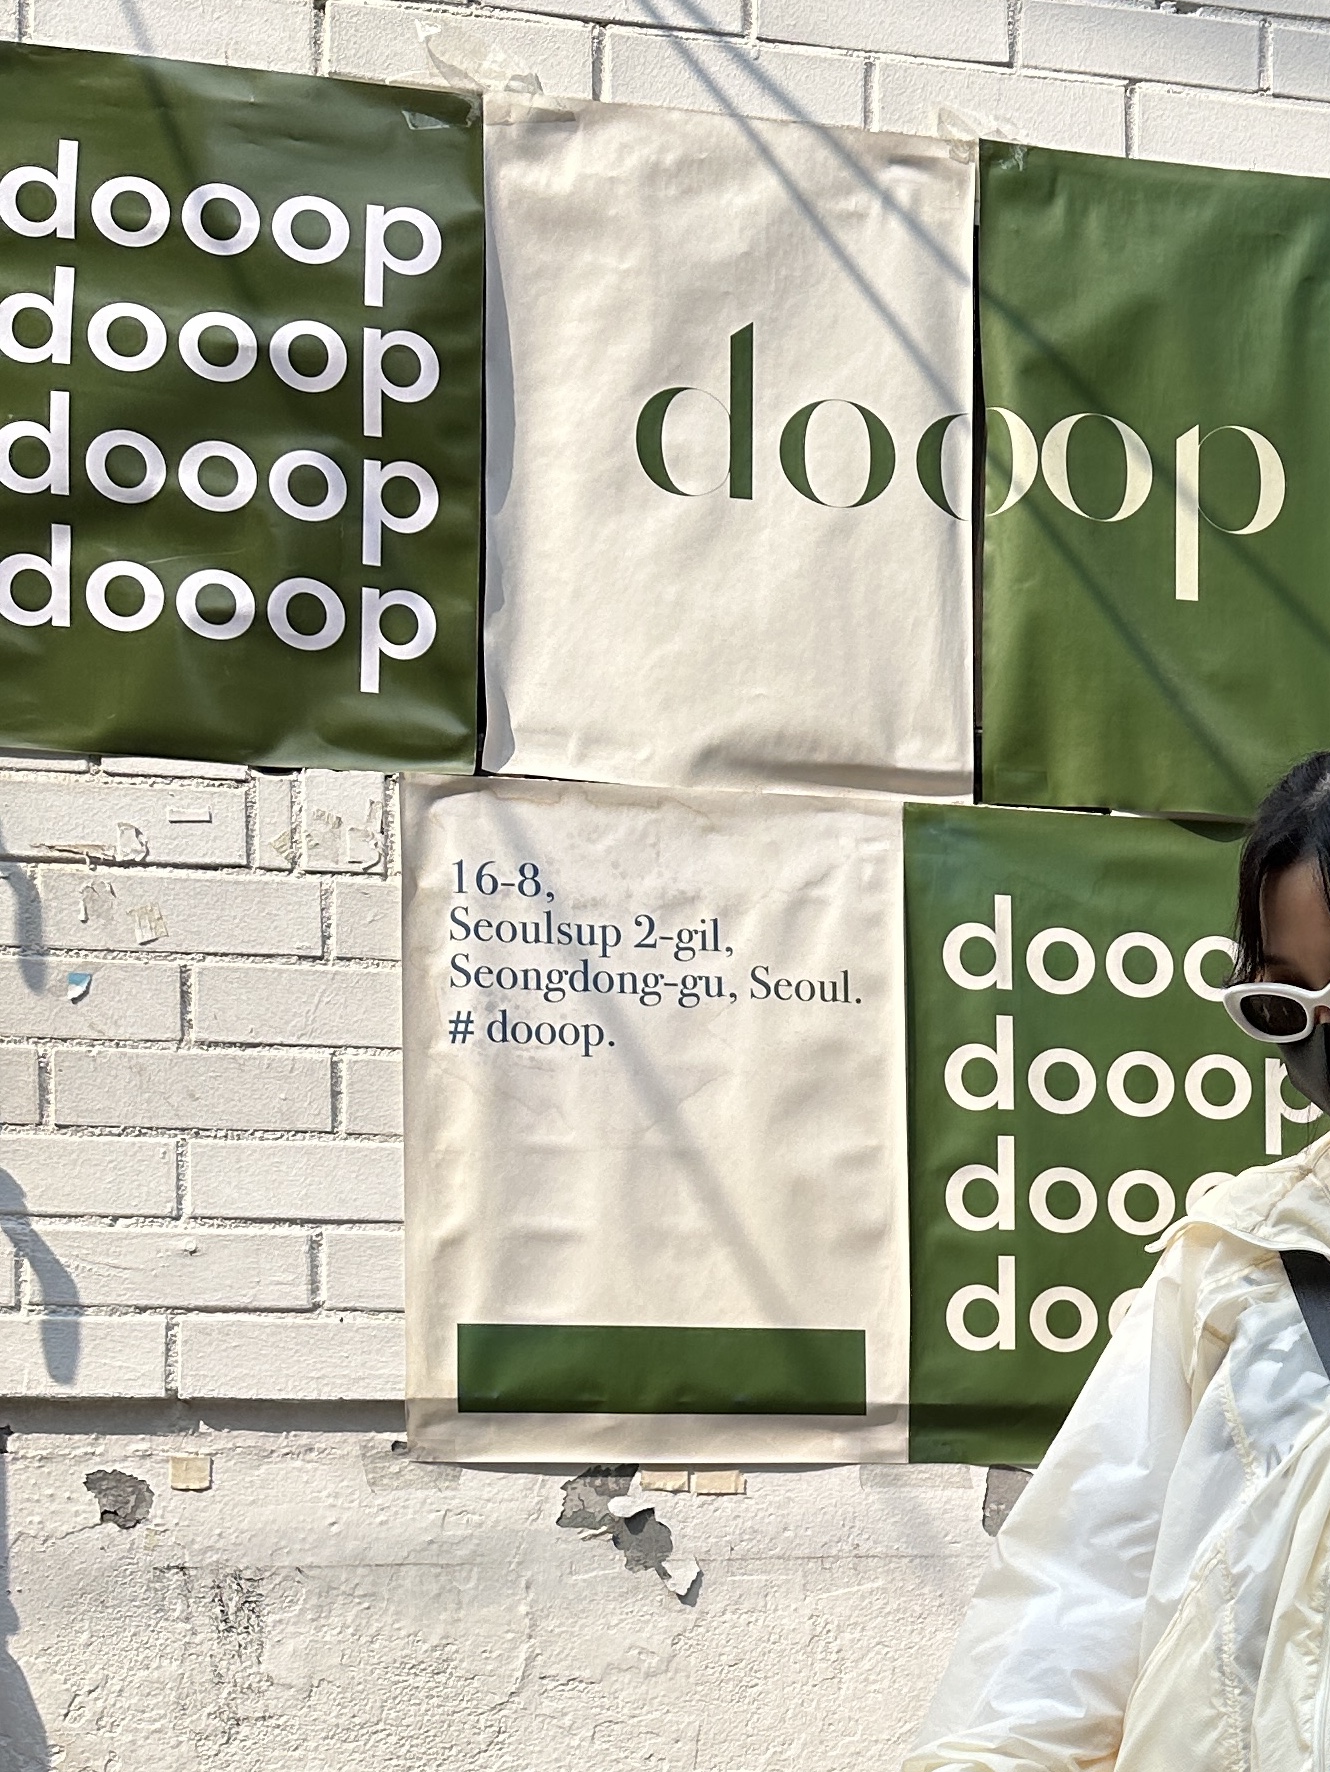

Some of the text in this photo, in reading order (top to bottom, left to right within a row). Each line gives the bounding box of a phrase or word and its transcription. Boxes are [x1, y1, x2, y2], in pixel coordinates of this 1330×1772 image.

[0, 140, 442, 308] dooop
[0, 266, 440, 438] dooop
[0, 391, 439, 567] dooop
[0, 524, 437, 694] dooop
[449, 906, 735, 959] Seoulsup 2-gil,
[450, 859, 557, 904] 16-8,
[449, 954, 864, 1007] Seongdong-gu, Seoul.
[942, 894, 1241, 1003] dooo
[486, 1009, 616, 1058] dooop.
